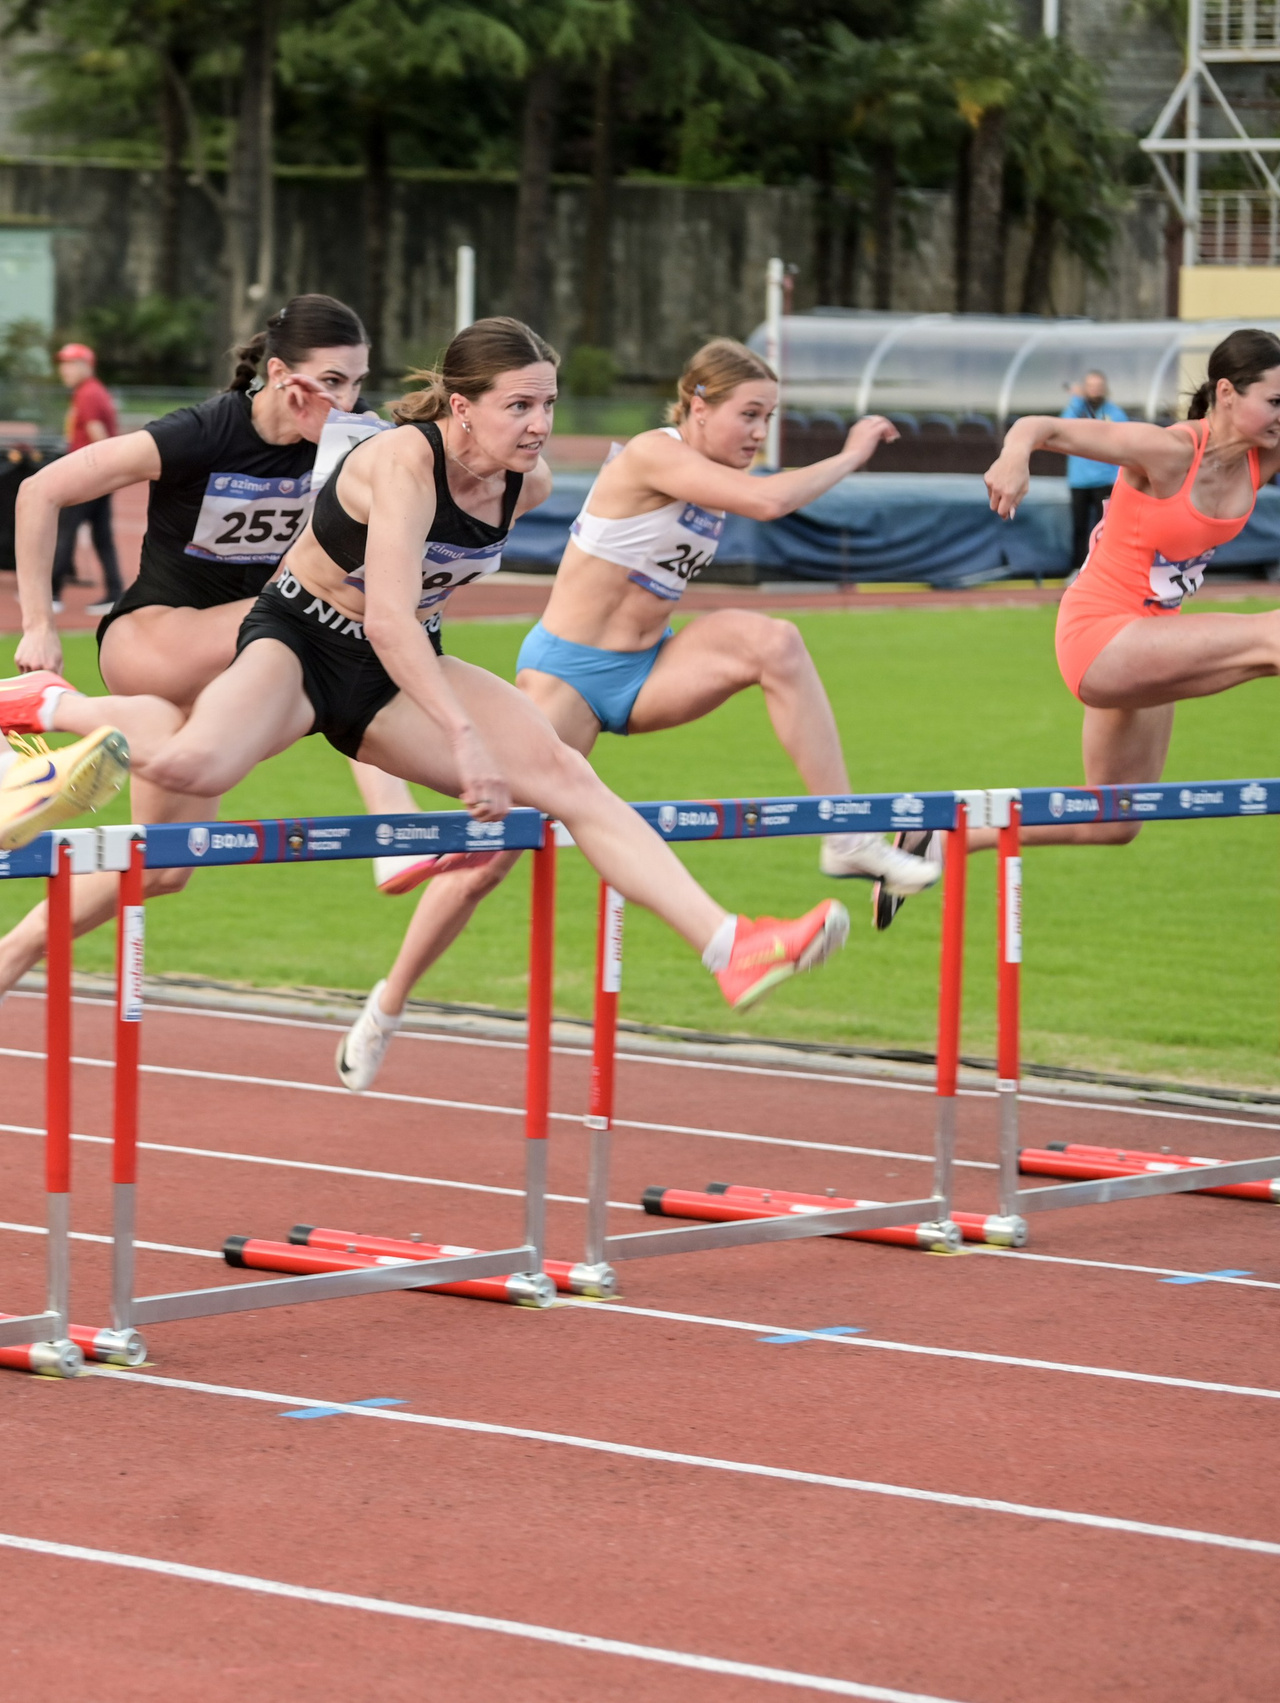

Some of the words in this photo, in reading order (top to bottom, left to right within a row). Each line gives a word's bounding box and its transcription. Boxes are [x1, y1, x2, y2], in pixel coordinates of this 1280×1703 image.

[230, 479, 271, 492] azimut
[215, 508, 304, 544] 253
[429, 545, 465, 559] zimut
[304, 598, 368, 640] NIK
[393, 823, 440, 840] azimut
[129, 937, 144, 999] polanik
